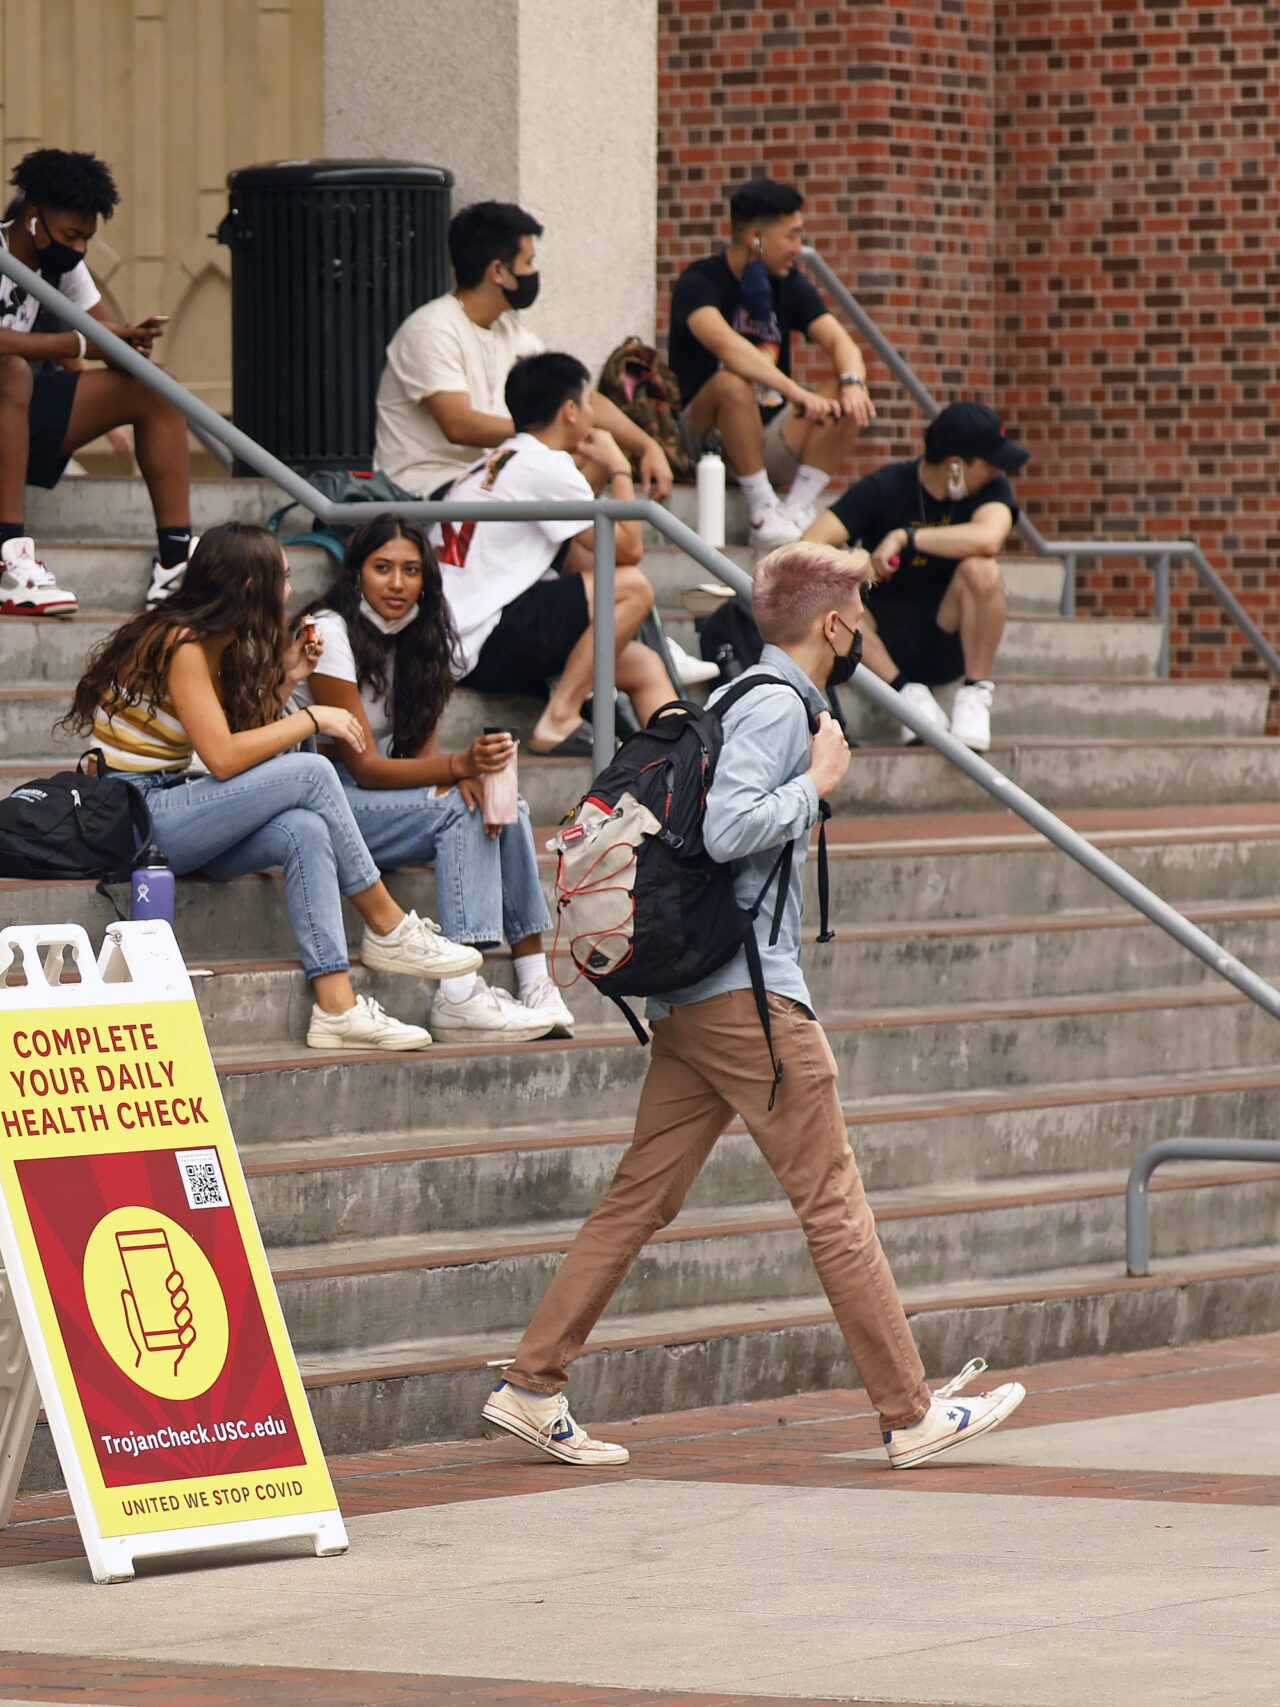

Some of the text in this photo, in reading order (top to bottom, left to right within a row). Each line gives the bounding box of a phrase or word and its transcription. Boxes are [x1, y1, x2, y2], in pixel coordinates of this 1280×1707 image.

[13, 1023, 158, 1058] COMPLETE
[10, 1060, 175, 1098] YOUR DAILY
[1, 1096, 209, 1138] HEALTH CHECK
[101, 1415, 288, 1457] TrojanCheck.USC.edu
[121, 1480, 303, 1516] UNITED WE STOP COVID
